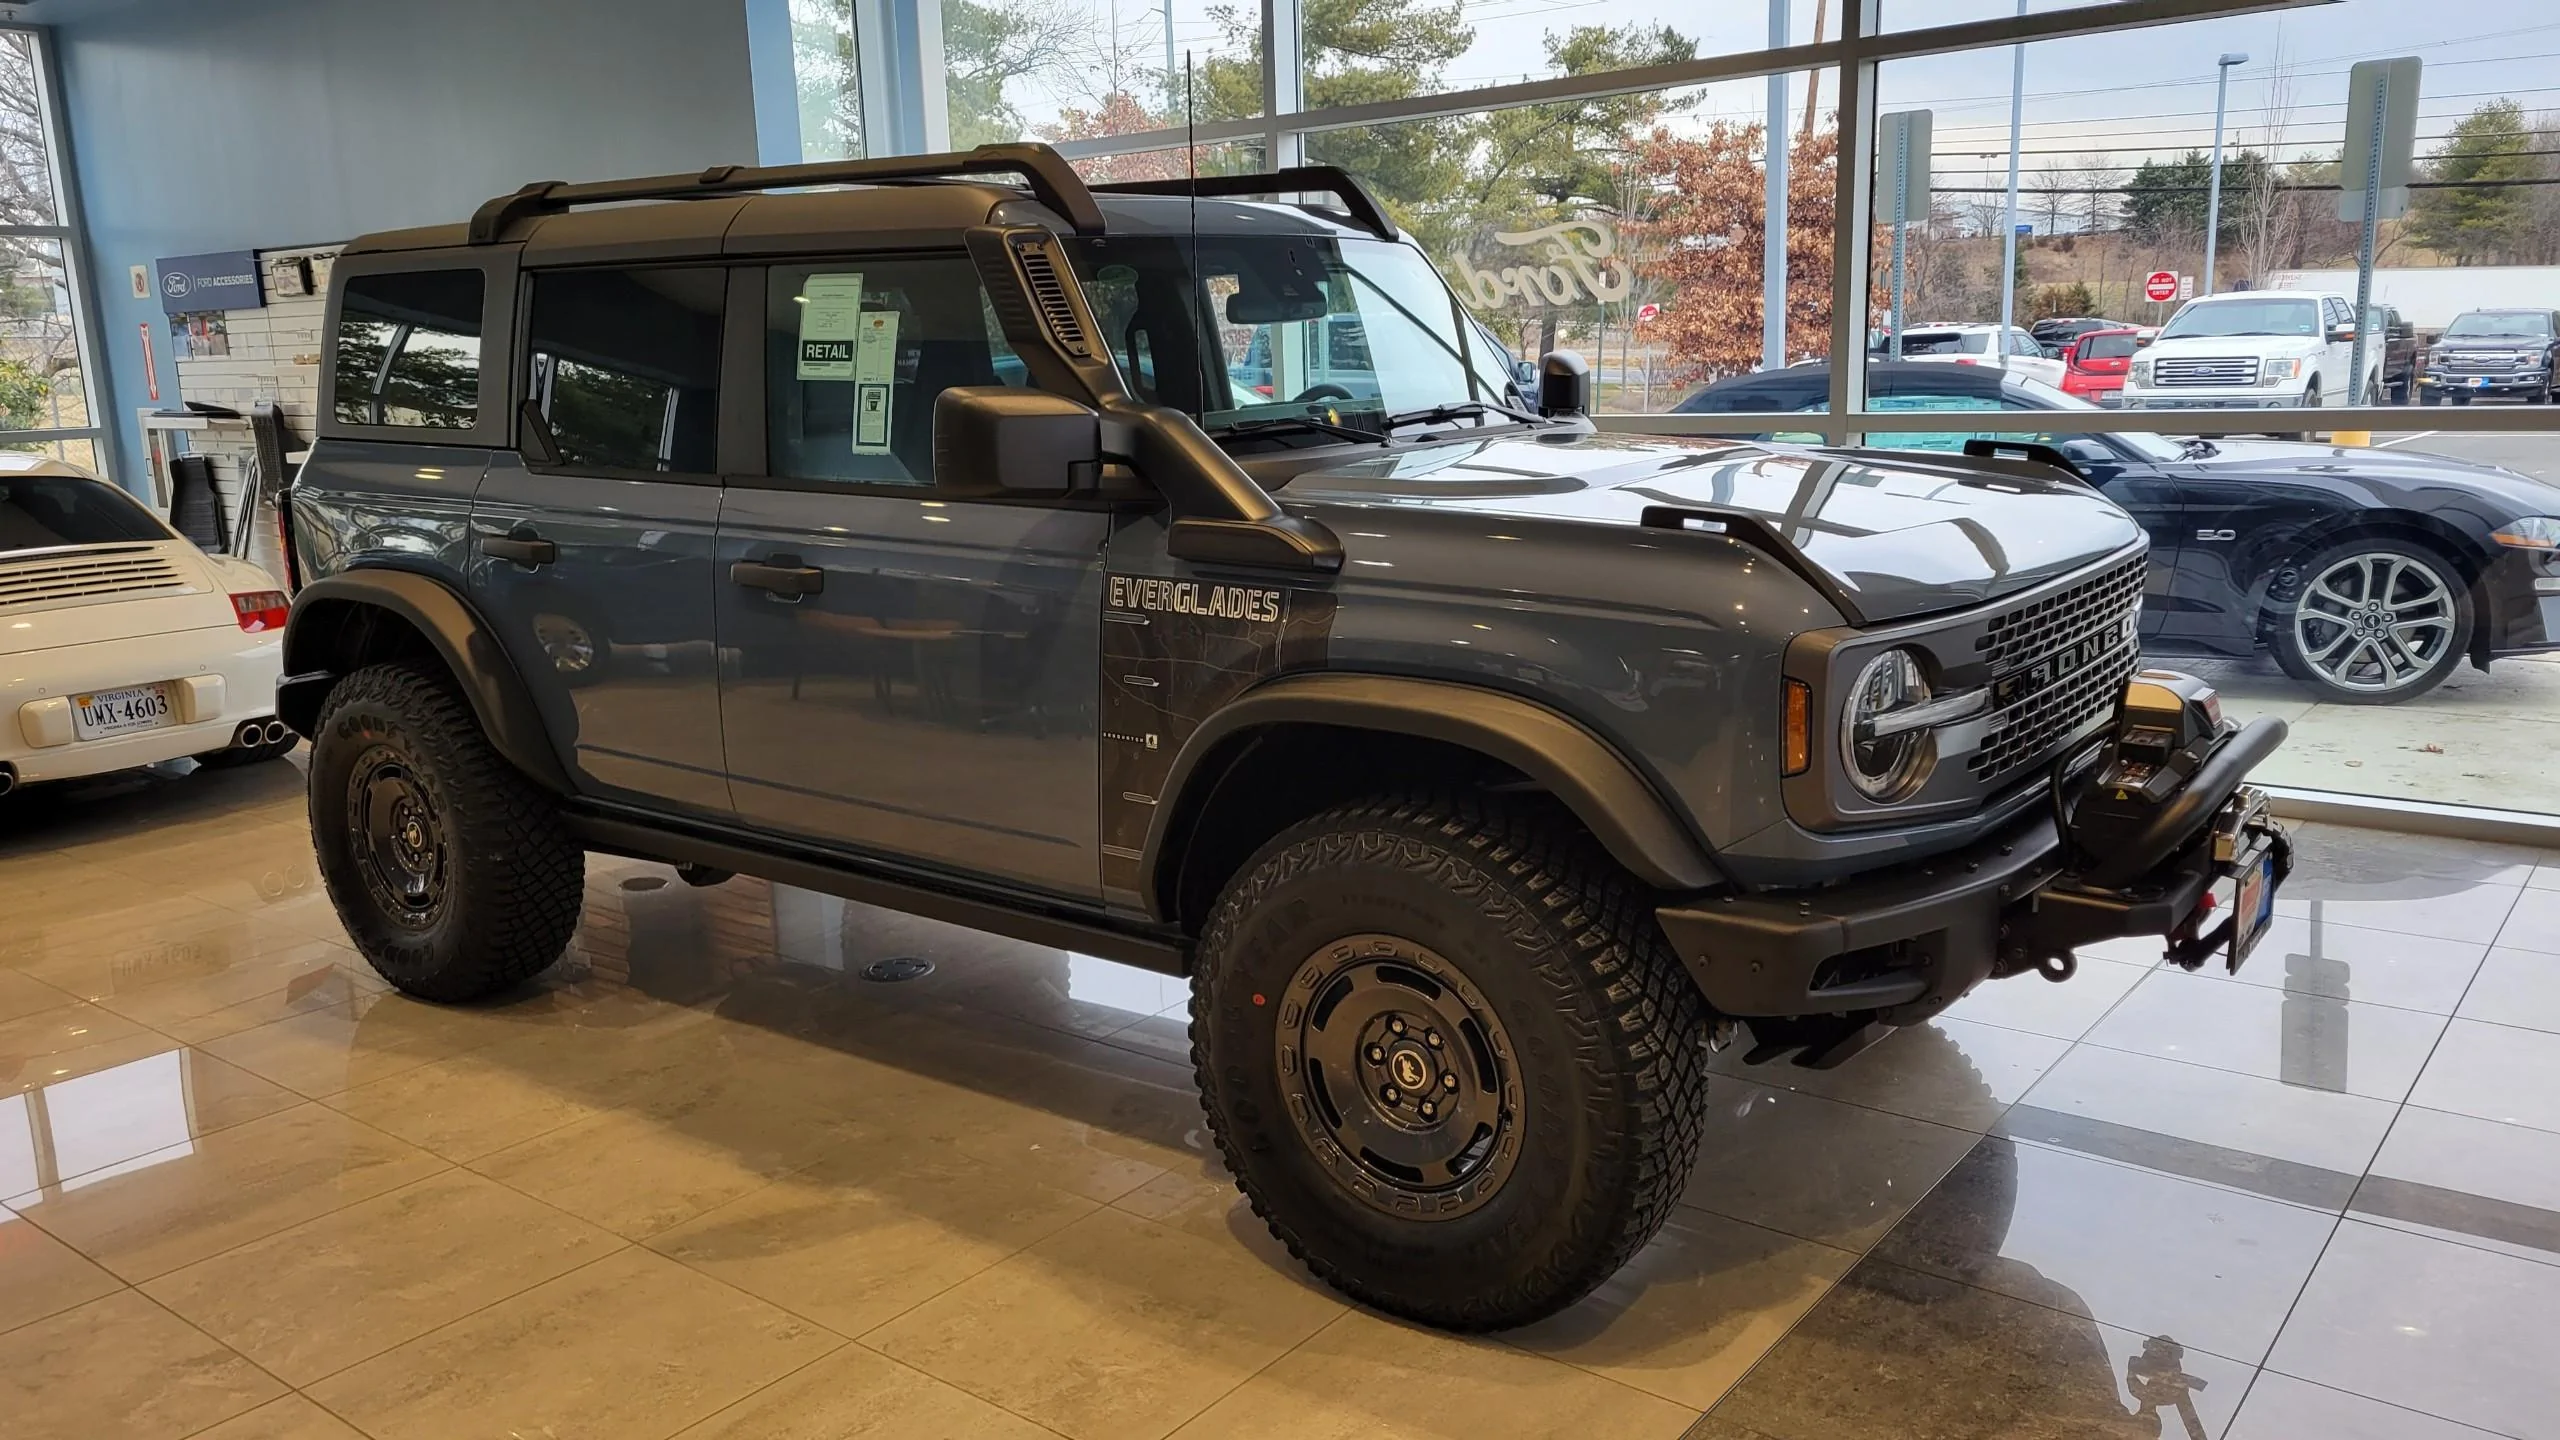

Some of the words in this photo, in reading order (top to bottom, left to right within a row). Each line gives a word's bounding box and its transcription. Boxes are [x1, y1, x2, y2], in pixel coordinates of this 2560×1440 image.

[167, 275, 186, 293] Ford
[197, 275, 212, 288] FORD
[213, 274, 254, 288] ACCESSORIES
[806, 343, 849, 359] RETAIL
[1109, 576, 1280, 622] EVERGLADES
[96, 689, 144, 703] VIRGINIA
[82, 695, 168, 727] UMX-4603
